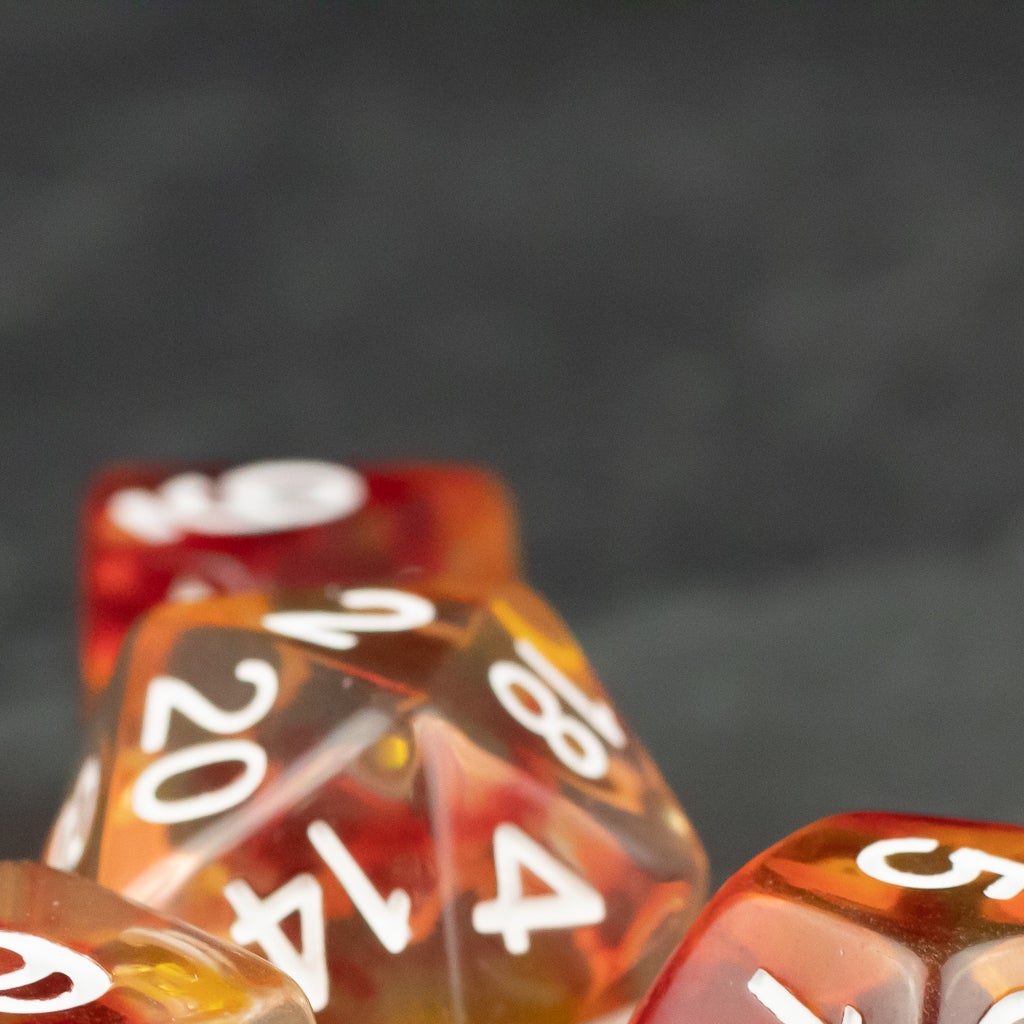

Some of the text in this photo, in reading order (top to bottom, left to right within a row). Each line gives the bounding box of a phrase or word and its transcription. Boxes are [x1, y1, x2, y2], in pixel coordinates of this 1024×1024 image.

[262, 588, 437, 651] 2
[131, 658, 280, 825] 20
[488, 638, 629, 780] 18
[224, 820, 410, 1013] 14
[473, 823, 606, 955] 4
[856, 837, 1024, 901] 5
